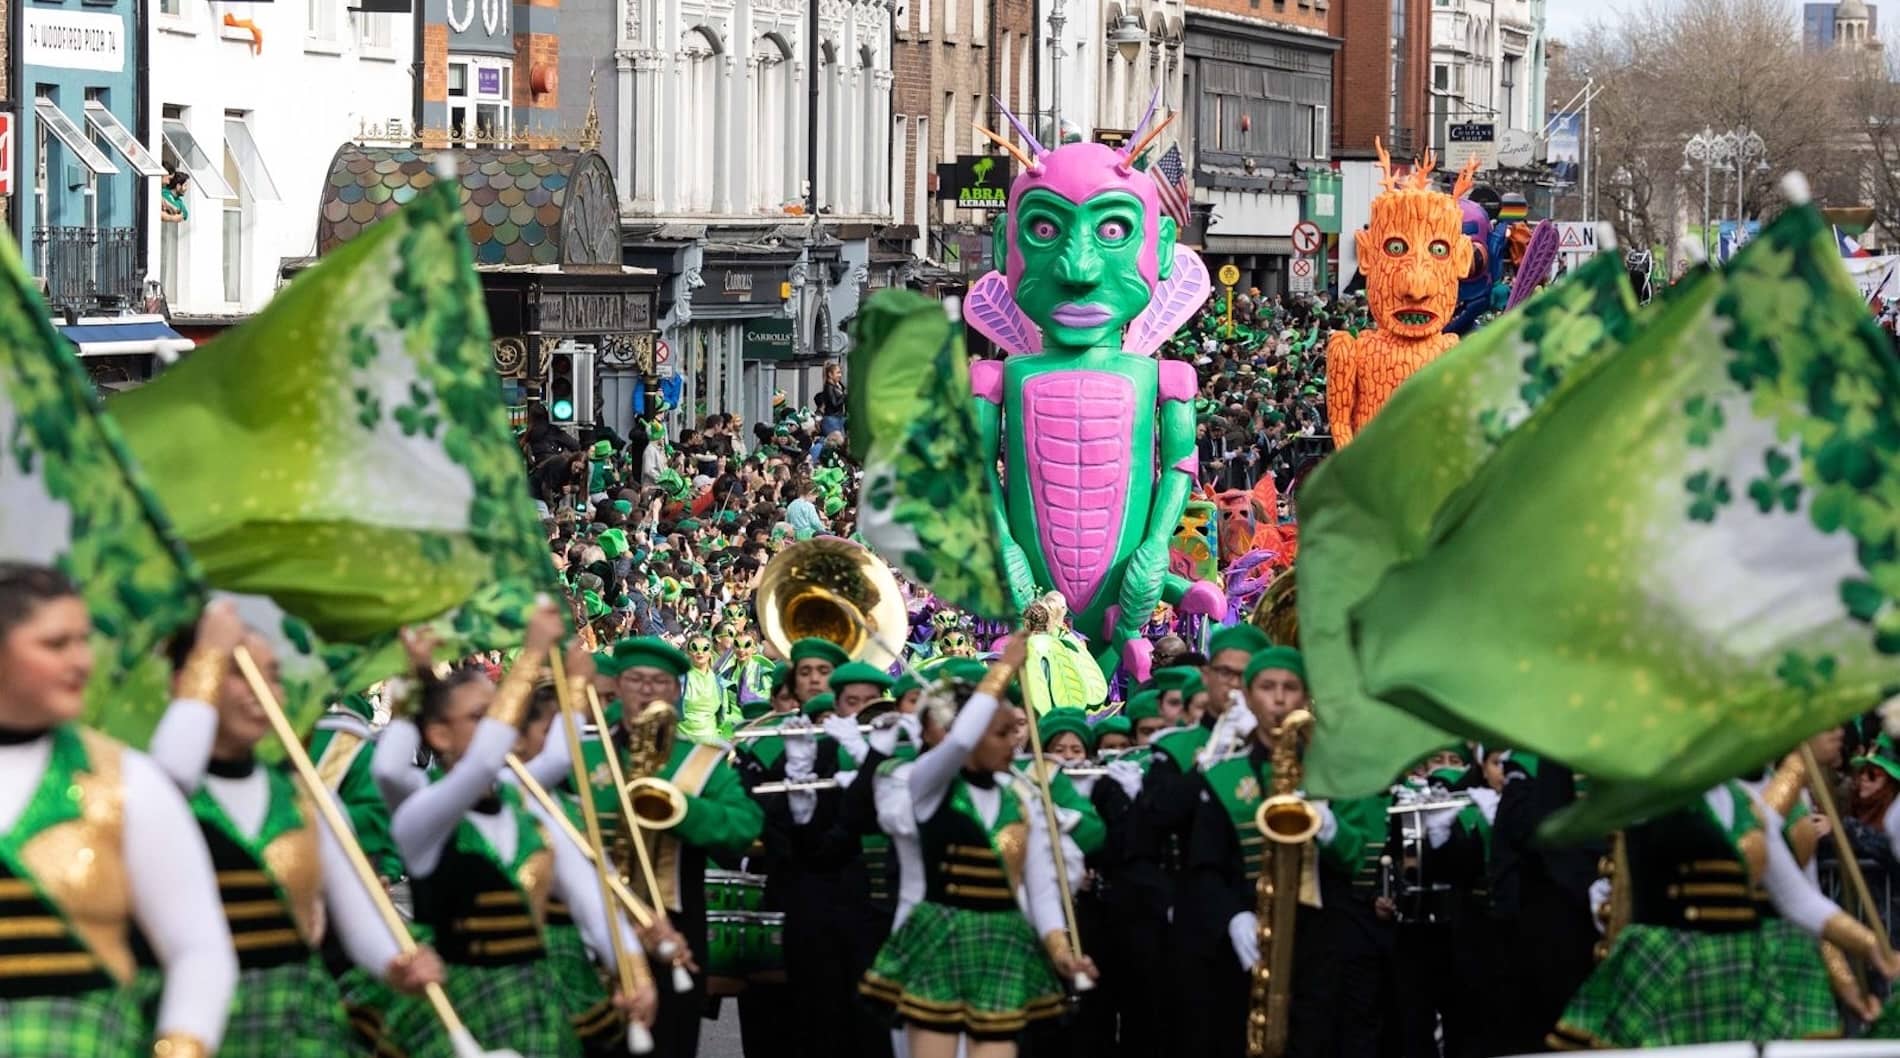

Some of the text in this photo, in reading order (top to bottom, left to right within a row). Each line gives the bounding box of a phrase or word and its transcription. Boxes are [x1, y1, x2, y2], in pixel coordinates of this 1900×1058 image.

[41, 24, 82, 51] WOODFIRED
[85, 28, 105, 52] PIZZA
[959, 187, 1006, 200] ABRA
[747, 330, 791, 342] CARROLLS
